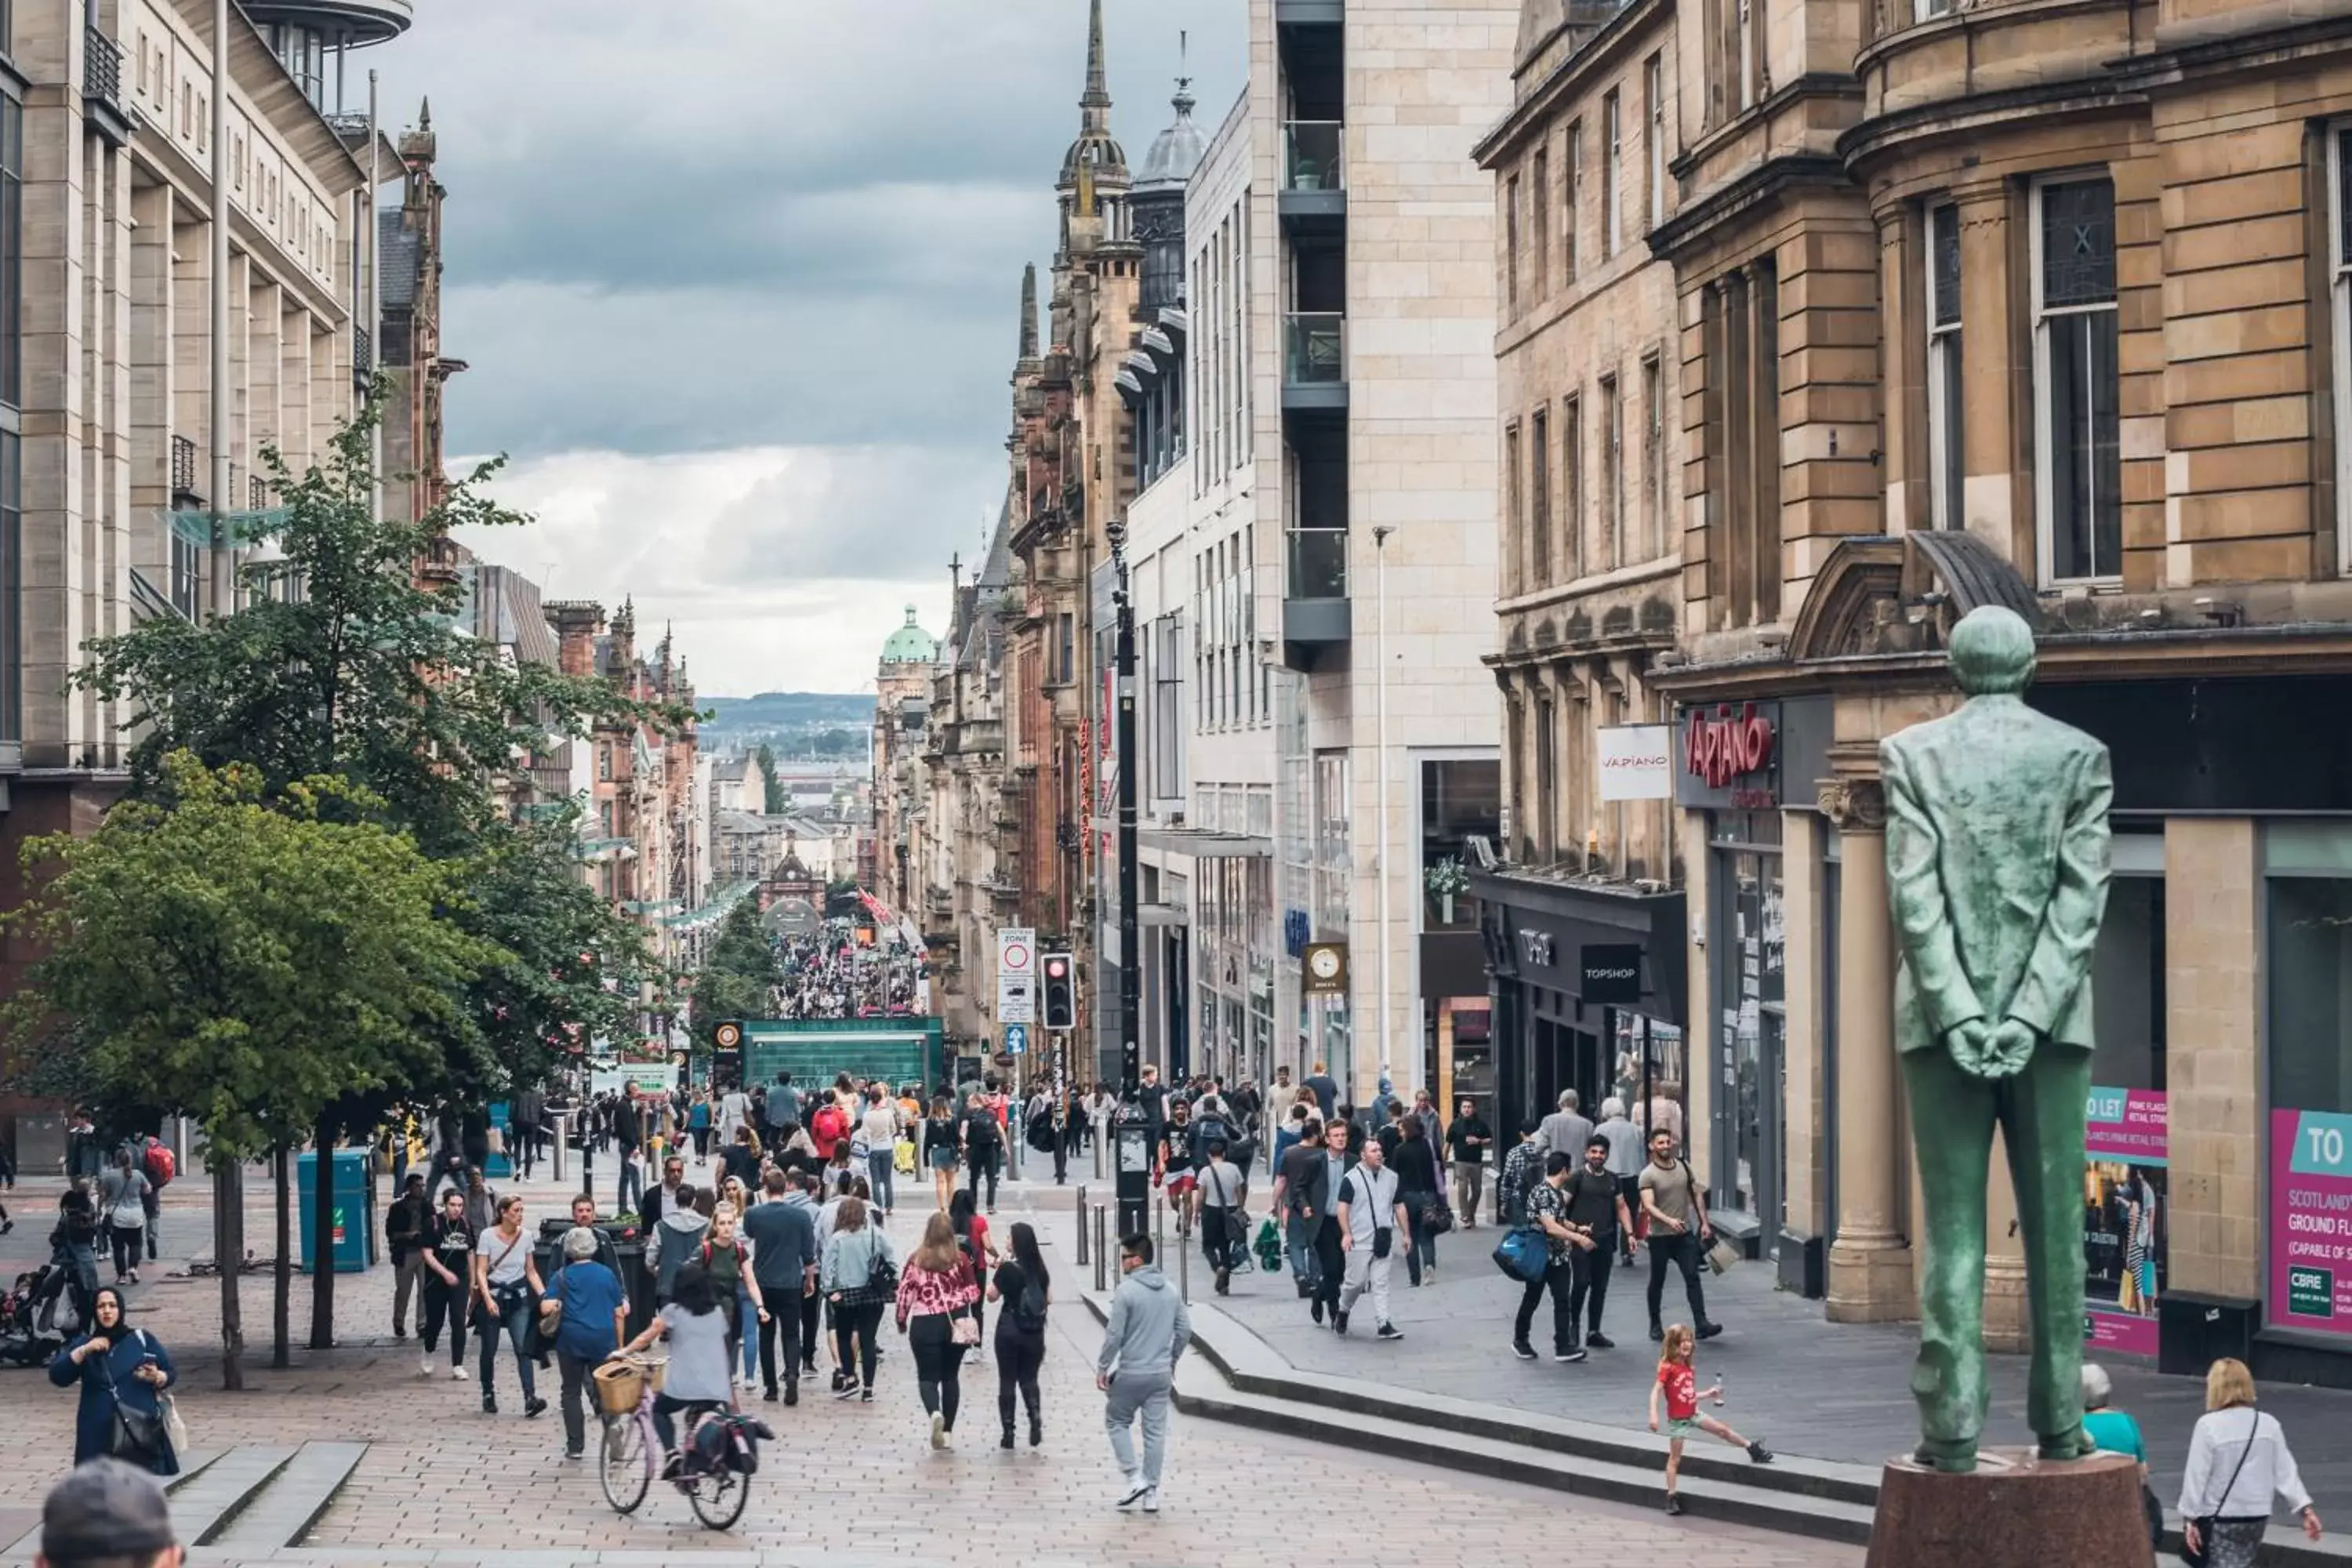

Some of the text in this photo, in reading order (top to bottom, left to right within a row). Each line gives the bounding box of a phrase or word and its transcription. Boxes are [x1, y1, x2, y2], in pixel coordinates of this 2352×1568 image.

[1683, 702, 1773, 789] VAPIANO
[1602, 755, 1668, 768] VAPIANO
[1585, 968, 1635, 979] TOPSHOP
[2100, 1098, 2120, 1117] LET
[2307, 1127, 2343, 1165] TO
[2288, 1214, 2336, 1234] GROUND
[2292, 1273, 2321, 1290] CBRE
